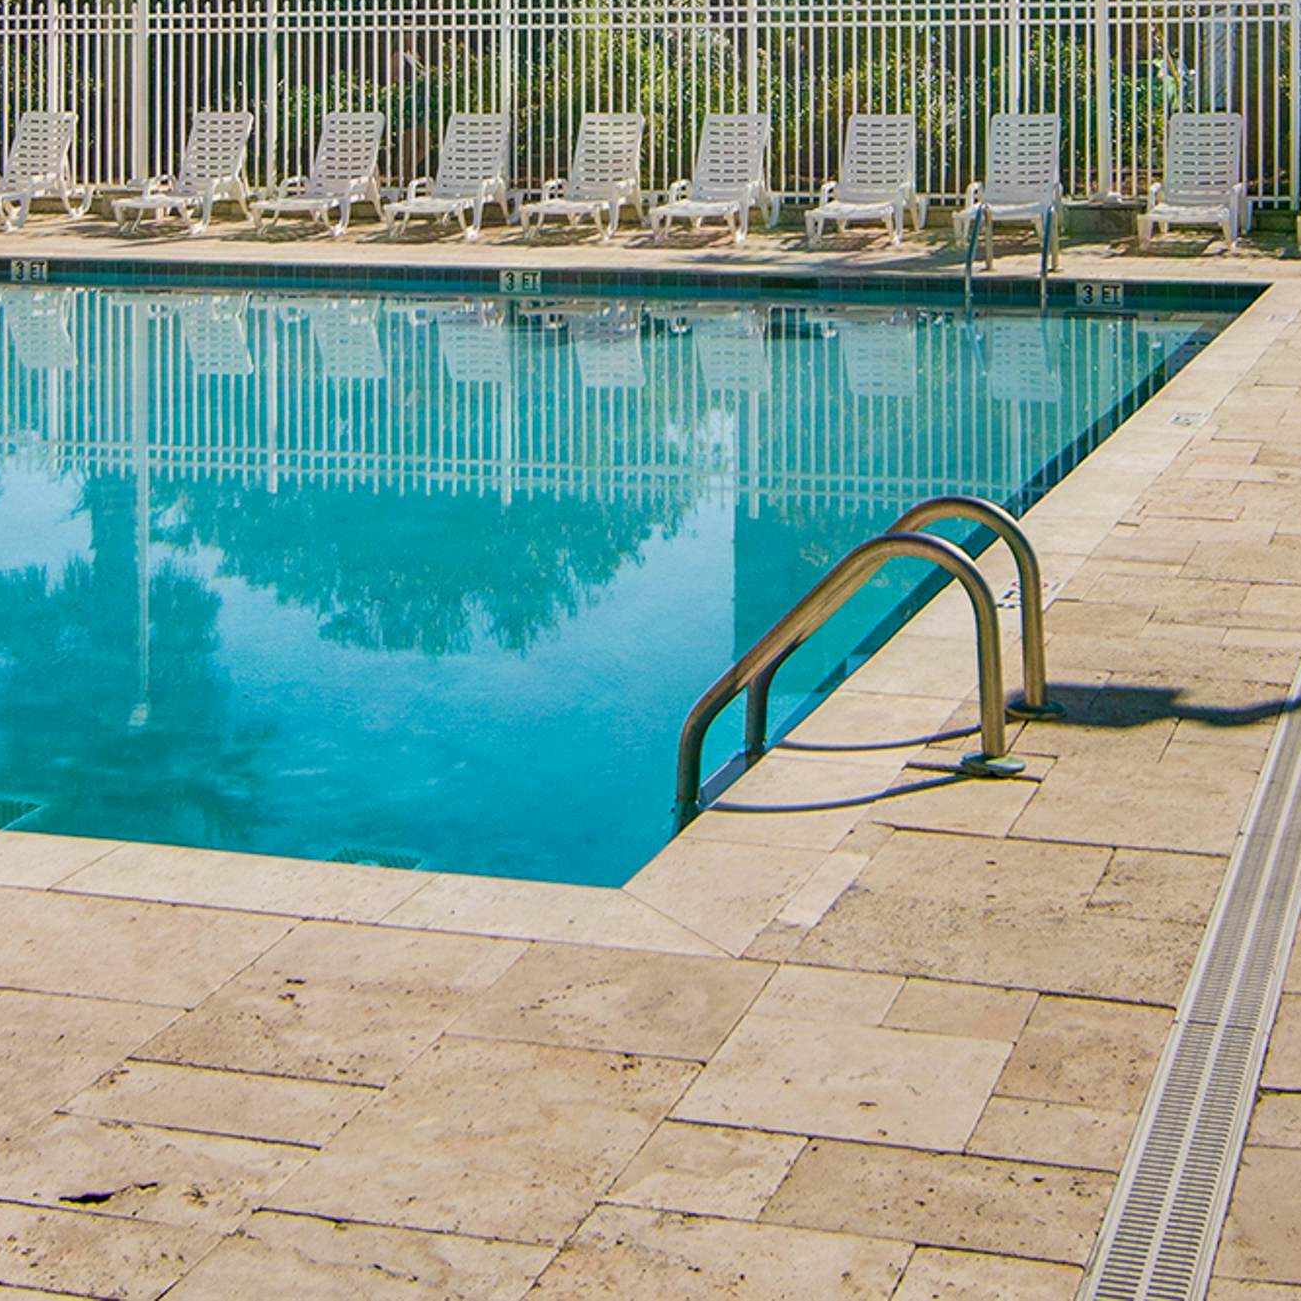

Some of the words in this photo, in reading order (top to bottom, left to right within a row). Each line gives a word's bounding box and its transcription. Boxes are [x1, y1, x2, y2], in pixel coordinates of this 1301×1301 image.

[15, 260, 25, 280] 3
[505, 271, 515, 292] 3
[1083, 284, 1093, 304] 3
